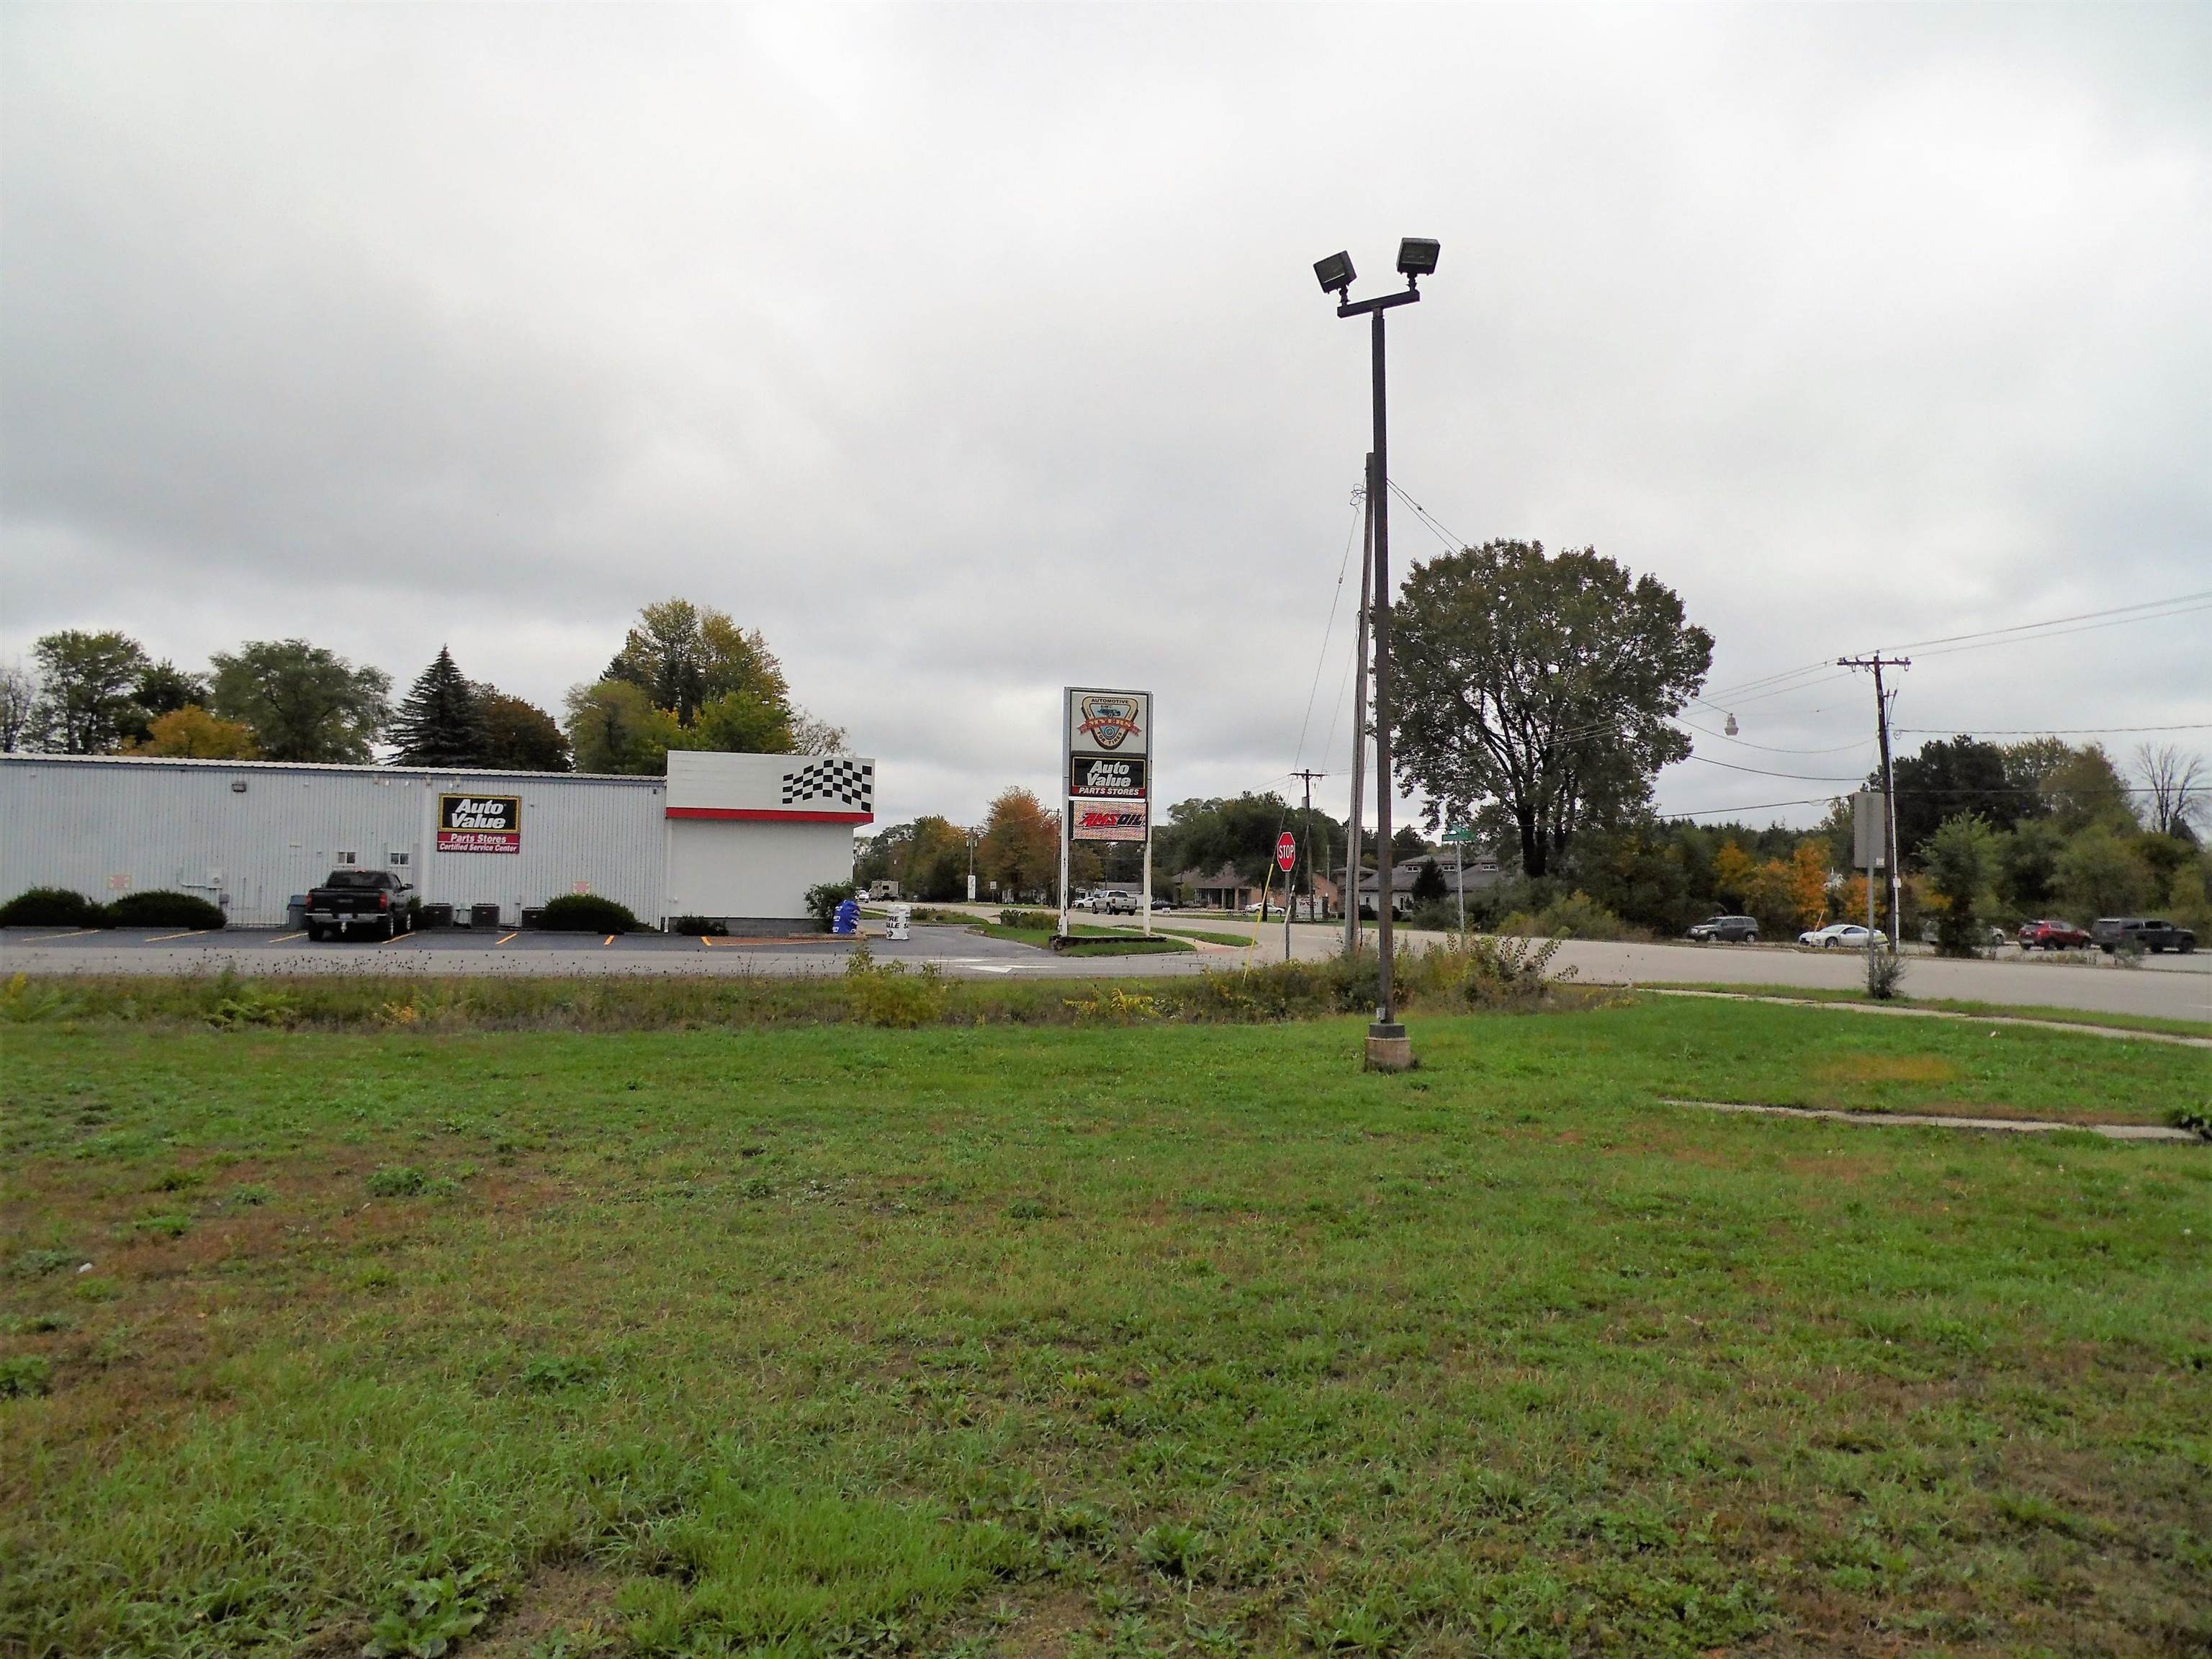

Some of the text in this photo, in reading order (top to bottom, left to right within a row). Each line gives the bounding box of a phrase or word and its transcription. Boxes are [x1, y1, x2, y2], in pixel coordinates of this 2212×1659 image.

[1097, 732, 1123, 745] FOR TIRES
[1089, 760, 1130, 775] Auto
[1087, 773, 1131, 787] Value
[455, 799, 504, 814] Auto
[451, 813, 506, 829] Value
[1078, 813, 1143, 827] AMSOIL
[451, 833, 507, 843] Parts Stores
[1279, 845, 1294, 859] STOP
